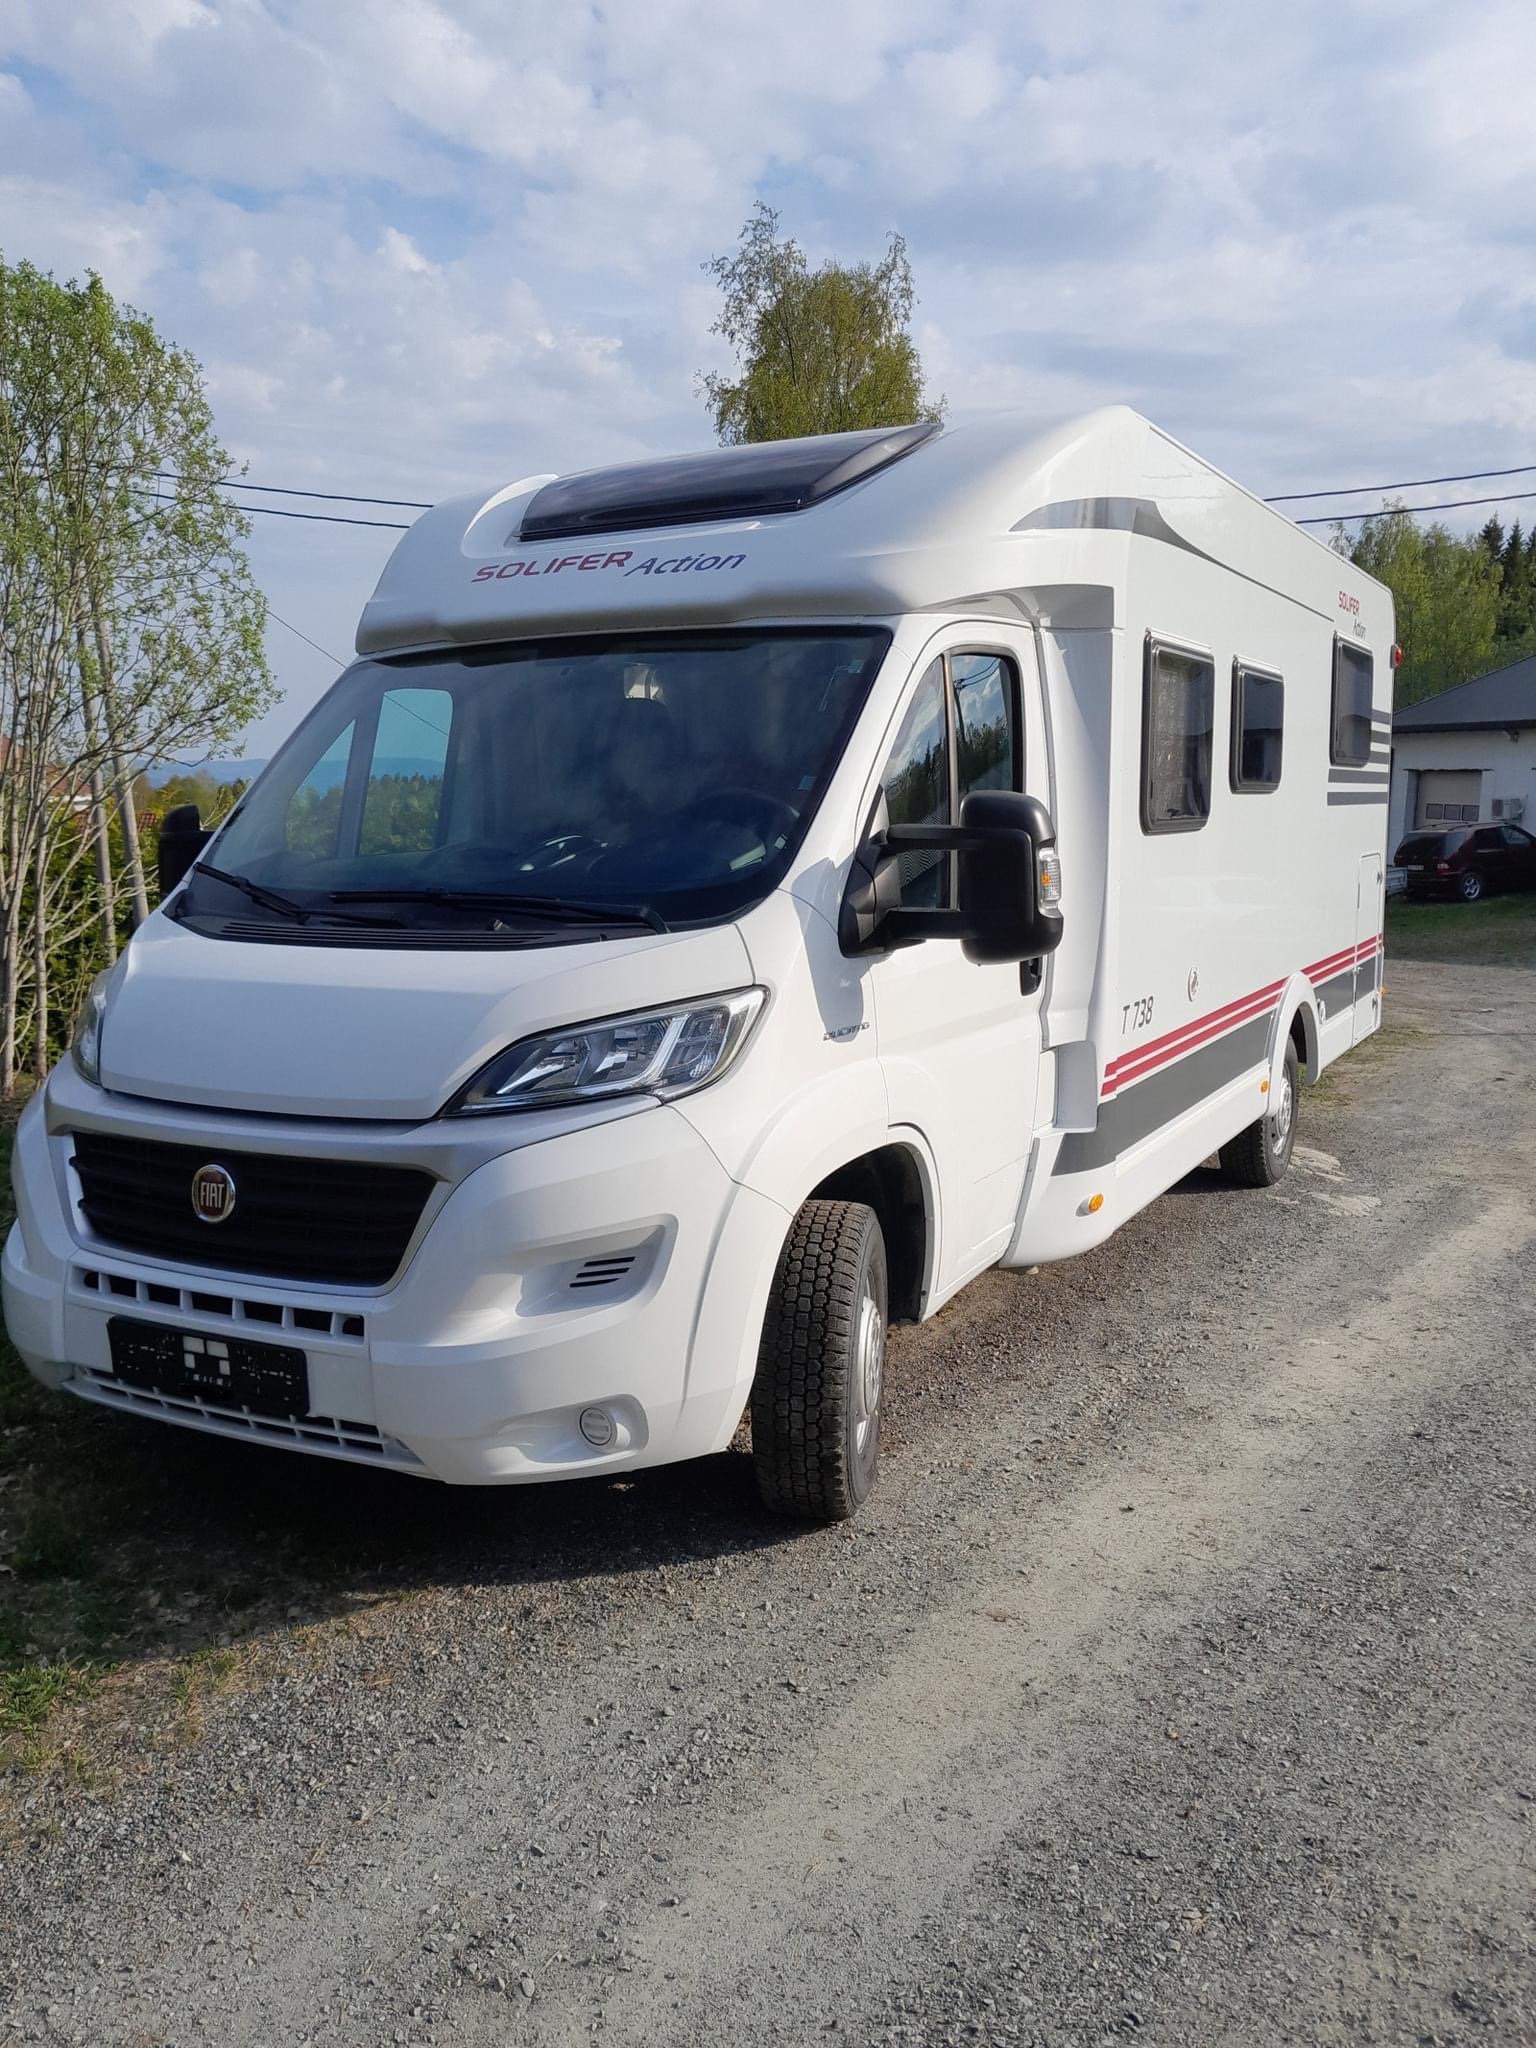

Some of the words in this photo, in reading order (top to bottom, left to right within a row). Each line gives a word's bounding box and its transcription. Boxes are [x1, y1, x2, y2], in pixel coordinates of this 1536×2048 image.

[472, 551, 633, 582] SOLIFER
[623, 553, 746, 577] Action
[1122, 1004, 1131, 1035] T
[1132, 995, 1154, 1031] 738
[200, 1182, 225, 1208] FIAT
